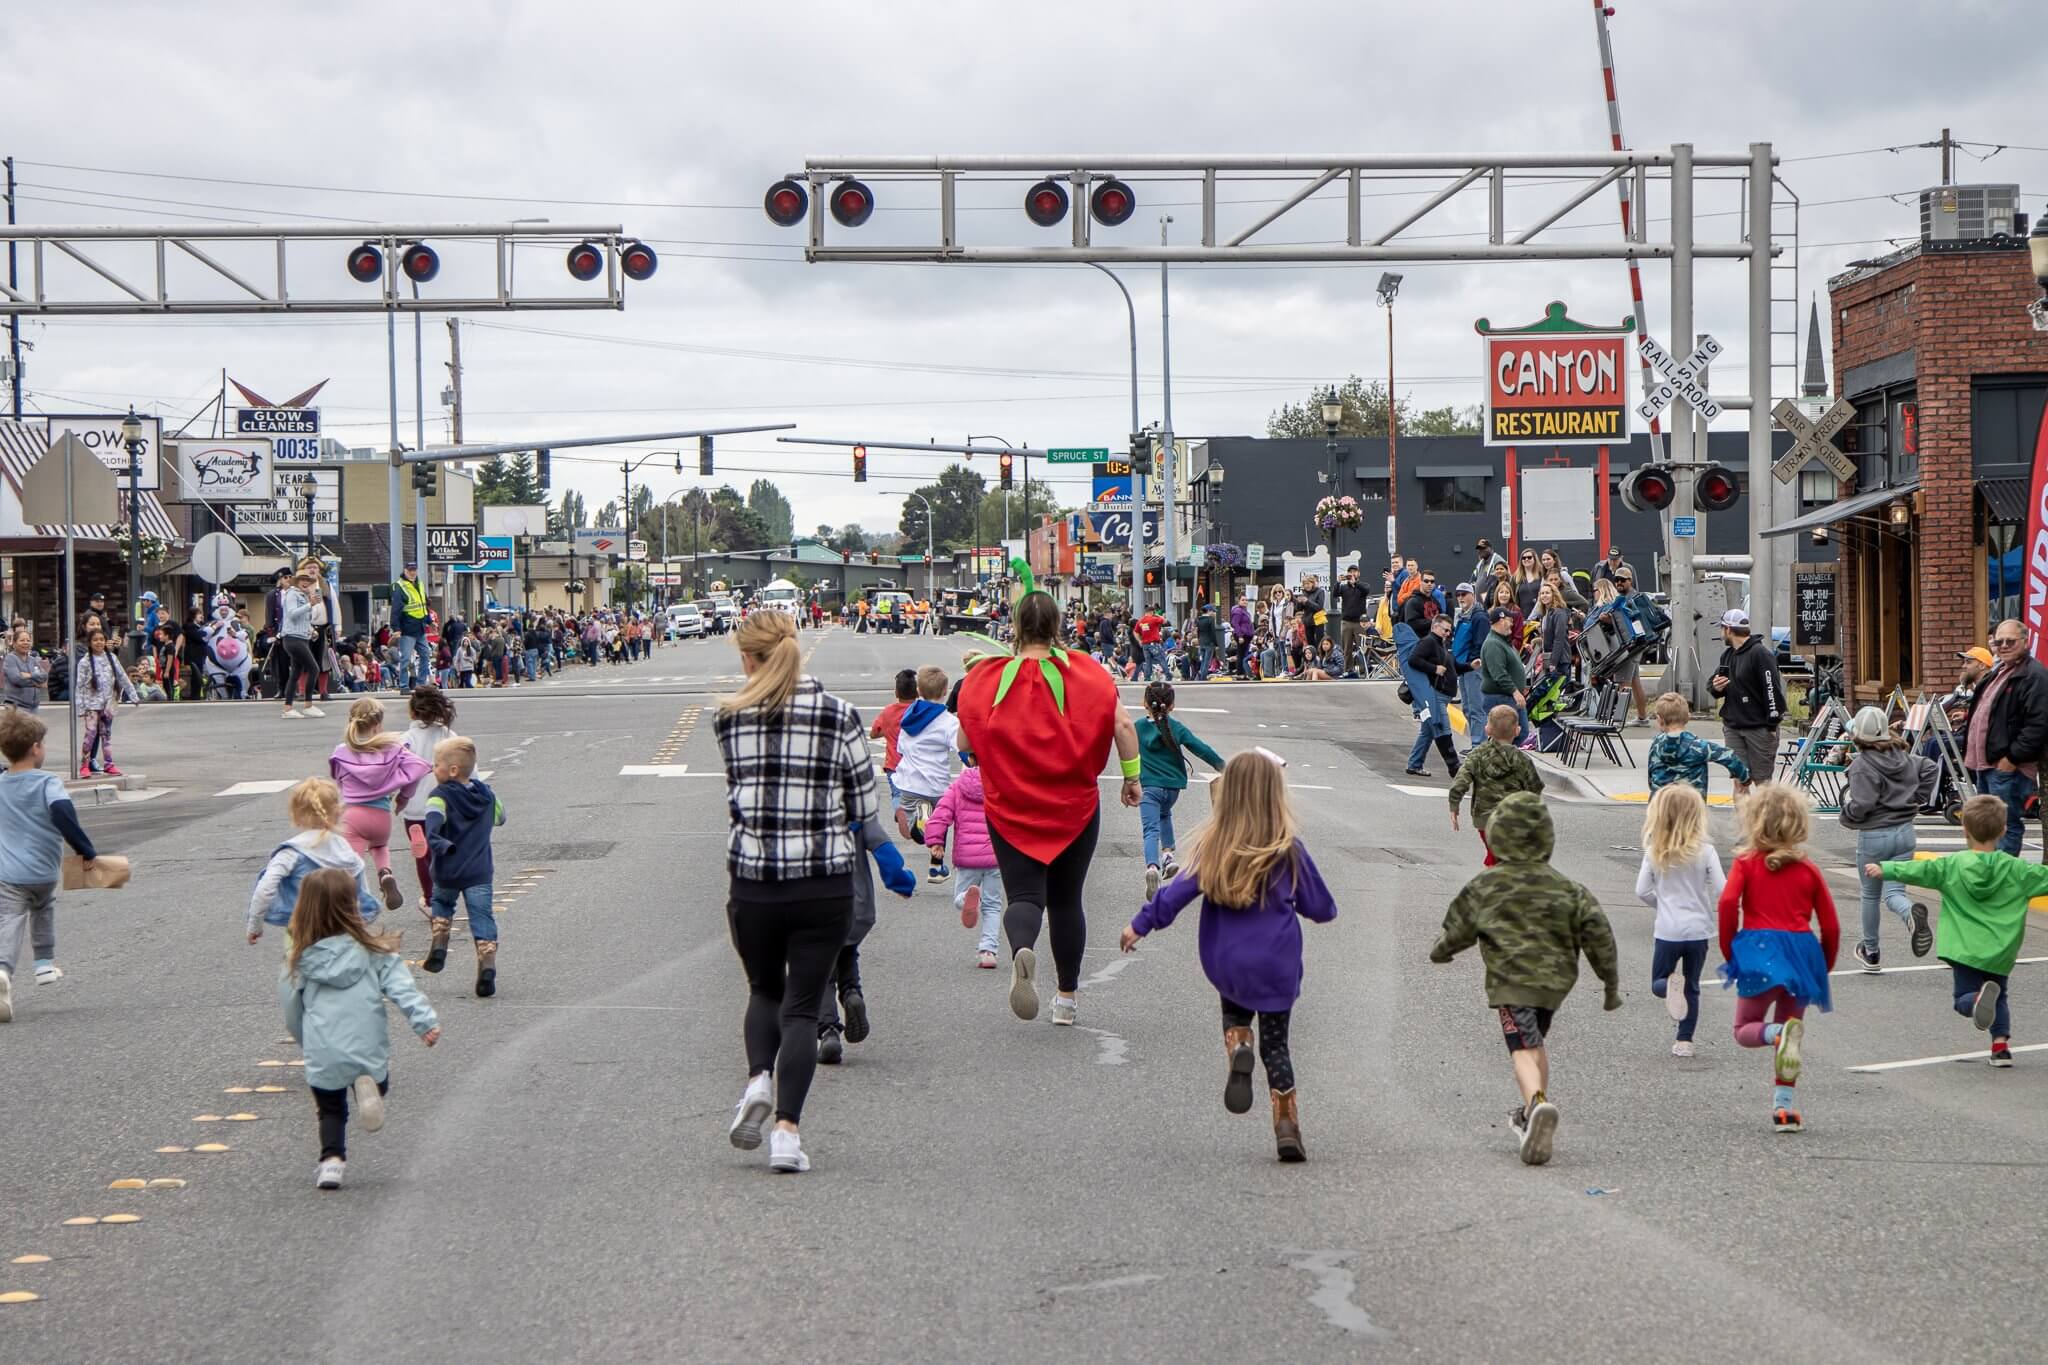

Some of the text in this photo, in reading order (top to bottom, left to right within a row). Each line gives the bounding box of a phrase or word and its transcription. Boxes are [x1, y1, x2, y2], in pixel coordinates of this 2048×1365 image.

[1497, 349, 1617, 396] CANTON
[1641, 341, 1718, 418] CROSSING
[254, 411, 302, 422] GLOW
[1496, 411, 1621, 436] RESTAURANT
[242, 421, 315, 432] CLEANERS
[75, 428, 149, 456] OWS
[1781, 407, 1848, 474] TRAIN WRECK
[1783, 409, 1848, 475] BAR GRILL
[100, 457, 143, 465] CLOTHIG
[210, 456, 248, 469] Academy
[1052, 451, 1104, 461] SPRUCE ST
[201, 467, 246, 485] Dance
[288, 499, 308, 509] YOU
[238, 512, 287, 521] CONTINUED
[426, 530, 469, 547] LOLA'S
[1100, 513, 1153, 550] Cae
[480, 550, 508, 558] STORE
